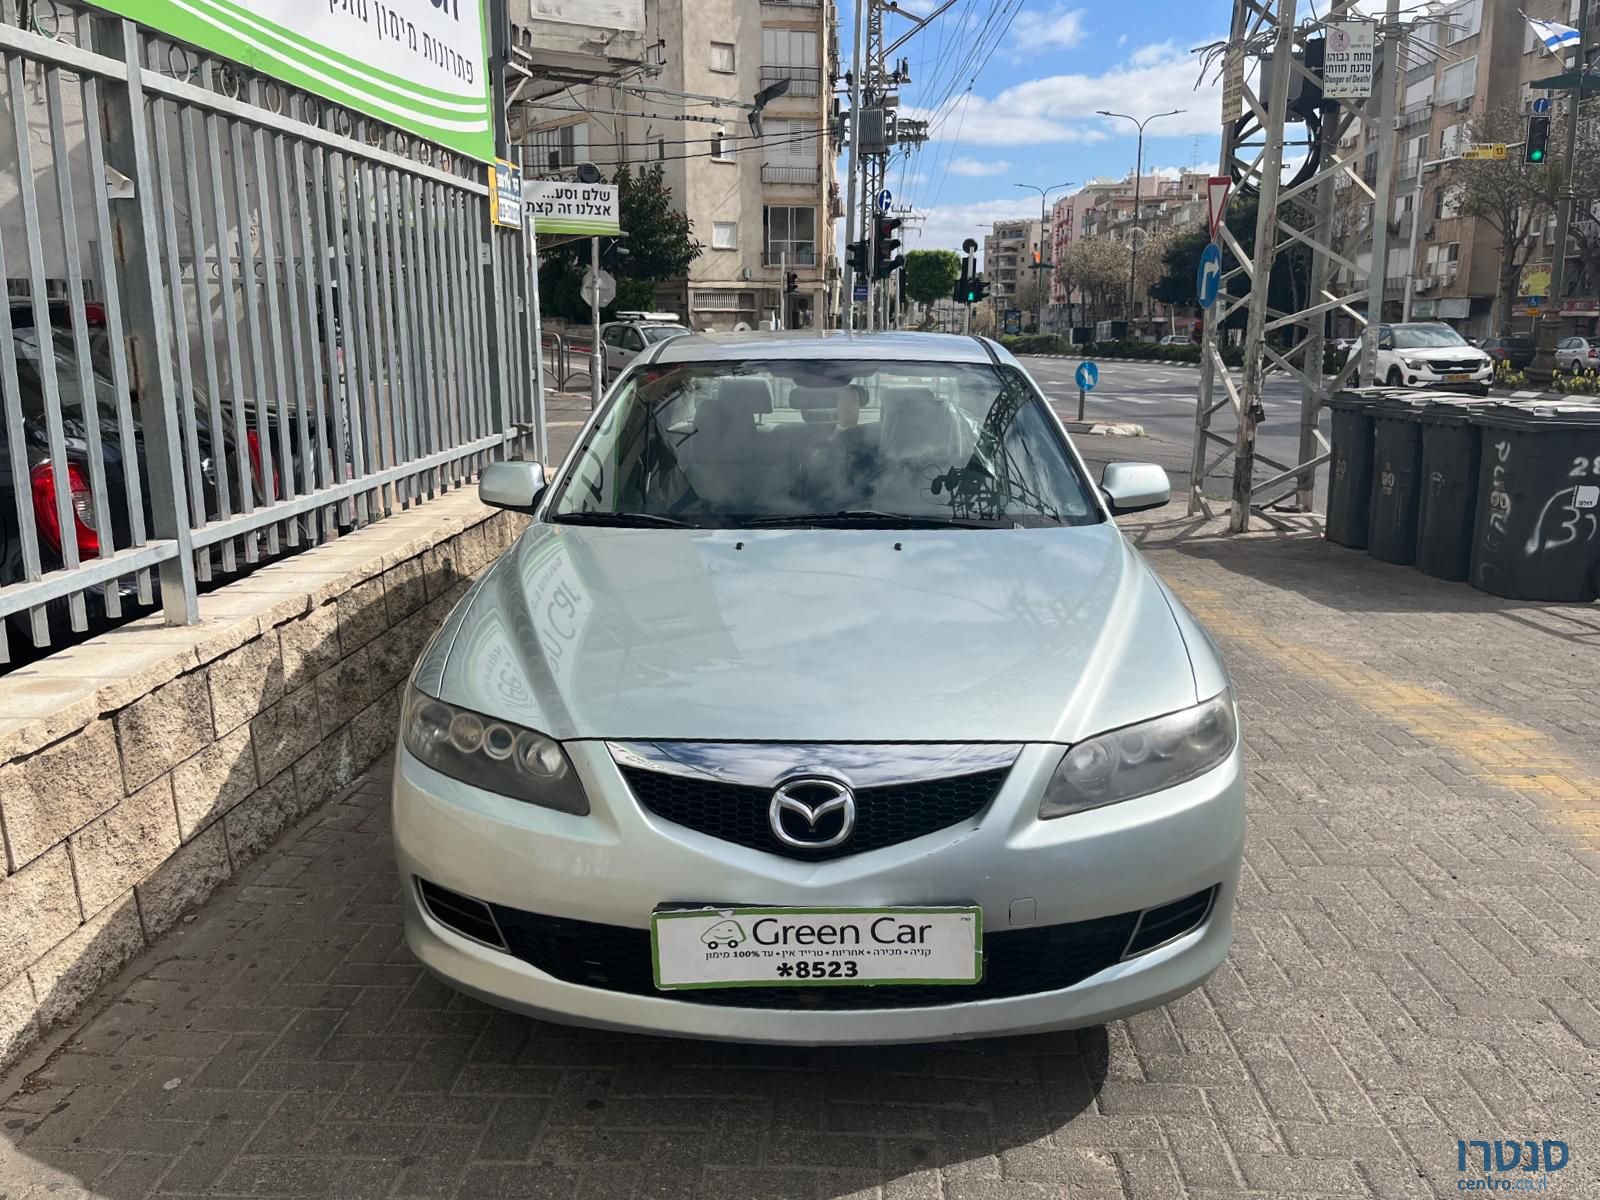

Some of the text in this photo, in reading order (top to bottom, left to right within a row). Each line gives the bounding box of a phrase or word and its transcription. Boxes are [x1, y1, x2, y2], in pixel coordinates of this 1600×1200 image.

[374, 1, 417, 52] מימון
[422, 31, 474, 85] פתרונות
[1325, 63, 1371, 73] סכנת מוות!
[1325, 74, 1345, 85] Danger
[1346, 74, 1352, 83] of
[542, 187, 611, 202] שלם וסע...
[525, 201, 612, 217] אצלנו זה קצת
[752, 916, 933, 946] Green Car
[705, 948, 932, 961] קניה מכירה אחריות טרייד אין עד 100% מימון
